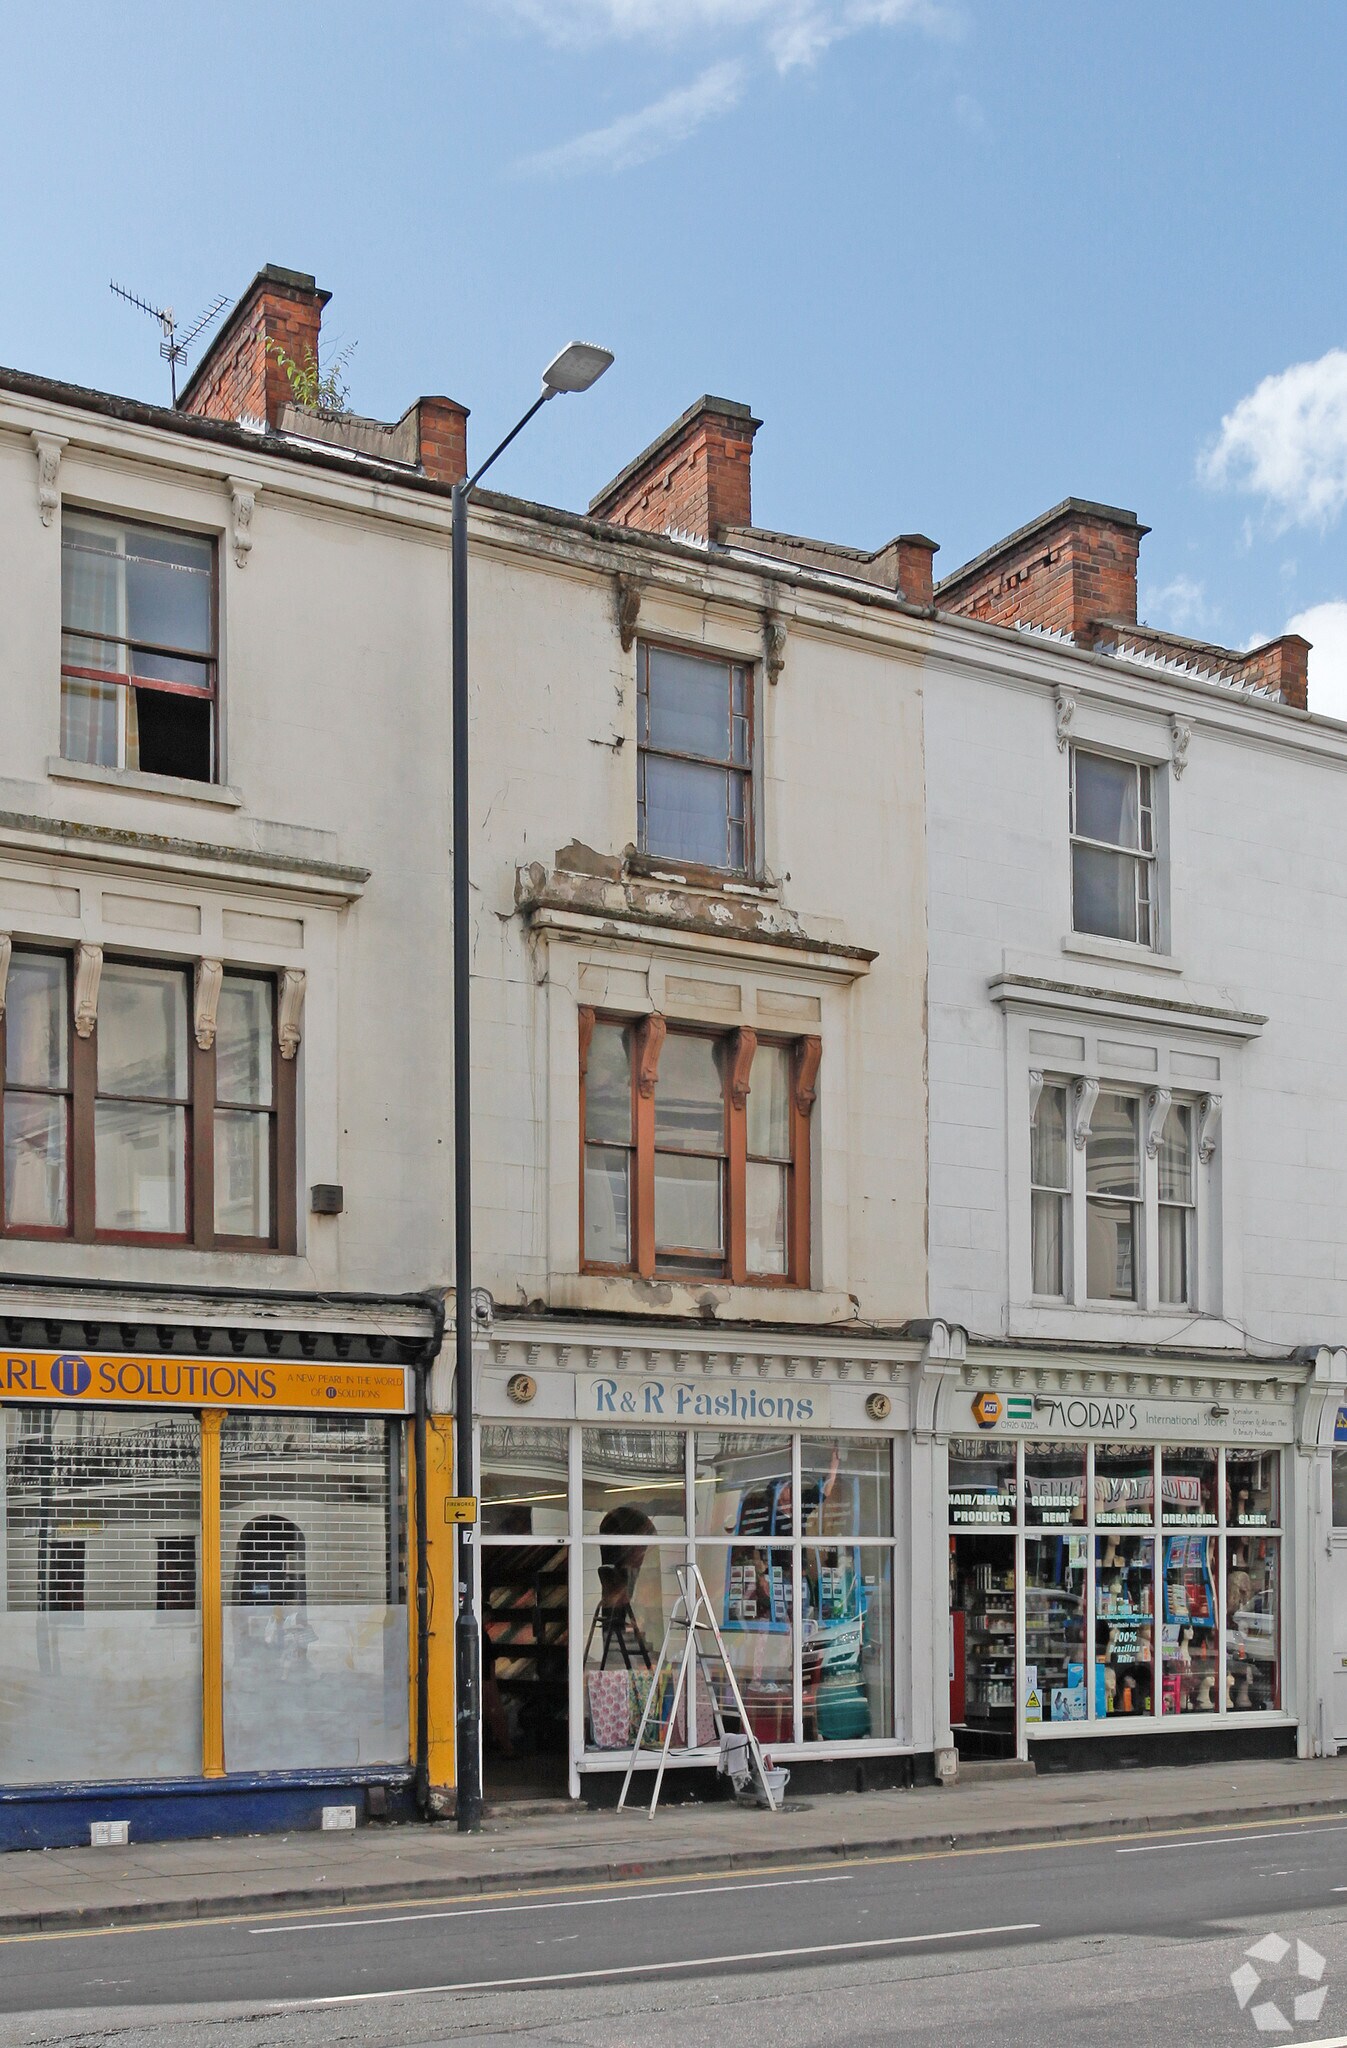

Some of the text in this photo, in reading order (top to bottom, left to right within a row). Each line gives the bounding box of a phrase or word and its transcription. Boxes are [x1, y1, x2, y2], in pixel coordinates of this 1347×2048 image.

[0, 1358, 277, 1399] RL IT SOLUTIONS
[287, 1373, 403, 1387] A NEW PEARL IN THE WORLD
[310, 1387, 322, 1398] OF
[337, 1388, 381, 1399] SOLUTIONS
[590, 1378, 814, 1421] R & R Fashions
[984, 1402, 997, 1412] ADT
[1048, 1400, 1228, 1431] MODAP'S International Stores
[1031, 1496, 1080, 1507] GODDESS
[953, 1511, 1011, 1523] PRODUCTS
[1096, 1513, 1153, 1525] SENSATIONNEL
[1162, 1513, 1218, 1525] DREAMGIRL
[1238, 1514, 1267, 1525] SLEEK
[465, 1531, 473, 1543] 7
[1113, 1631, 1138, 1643] 100%
[1108, 1644, 1141, 1653] Brazilian
[1116, 1653, 1136, 1664] Hair
